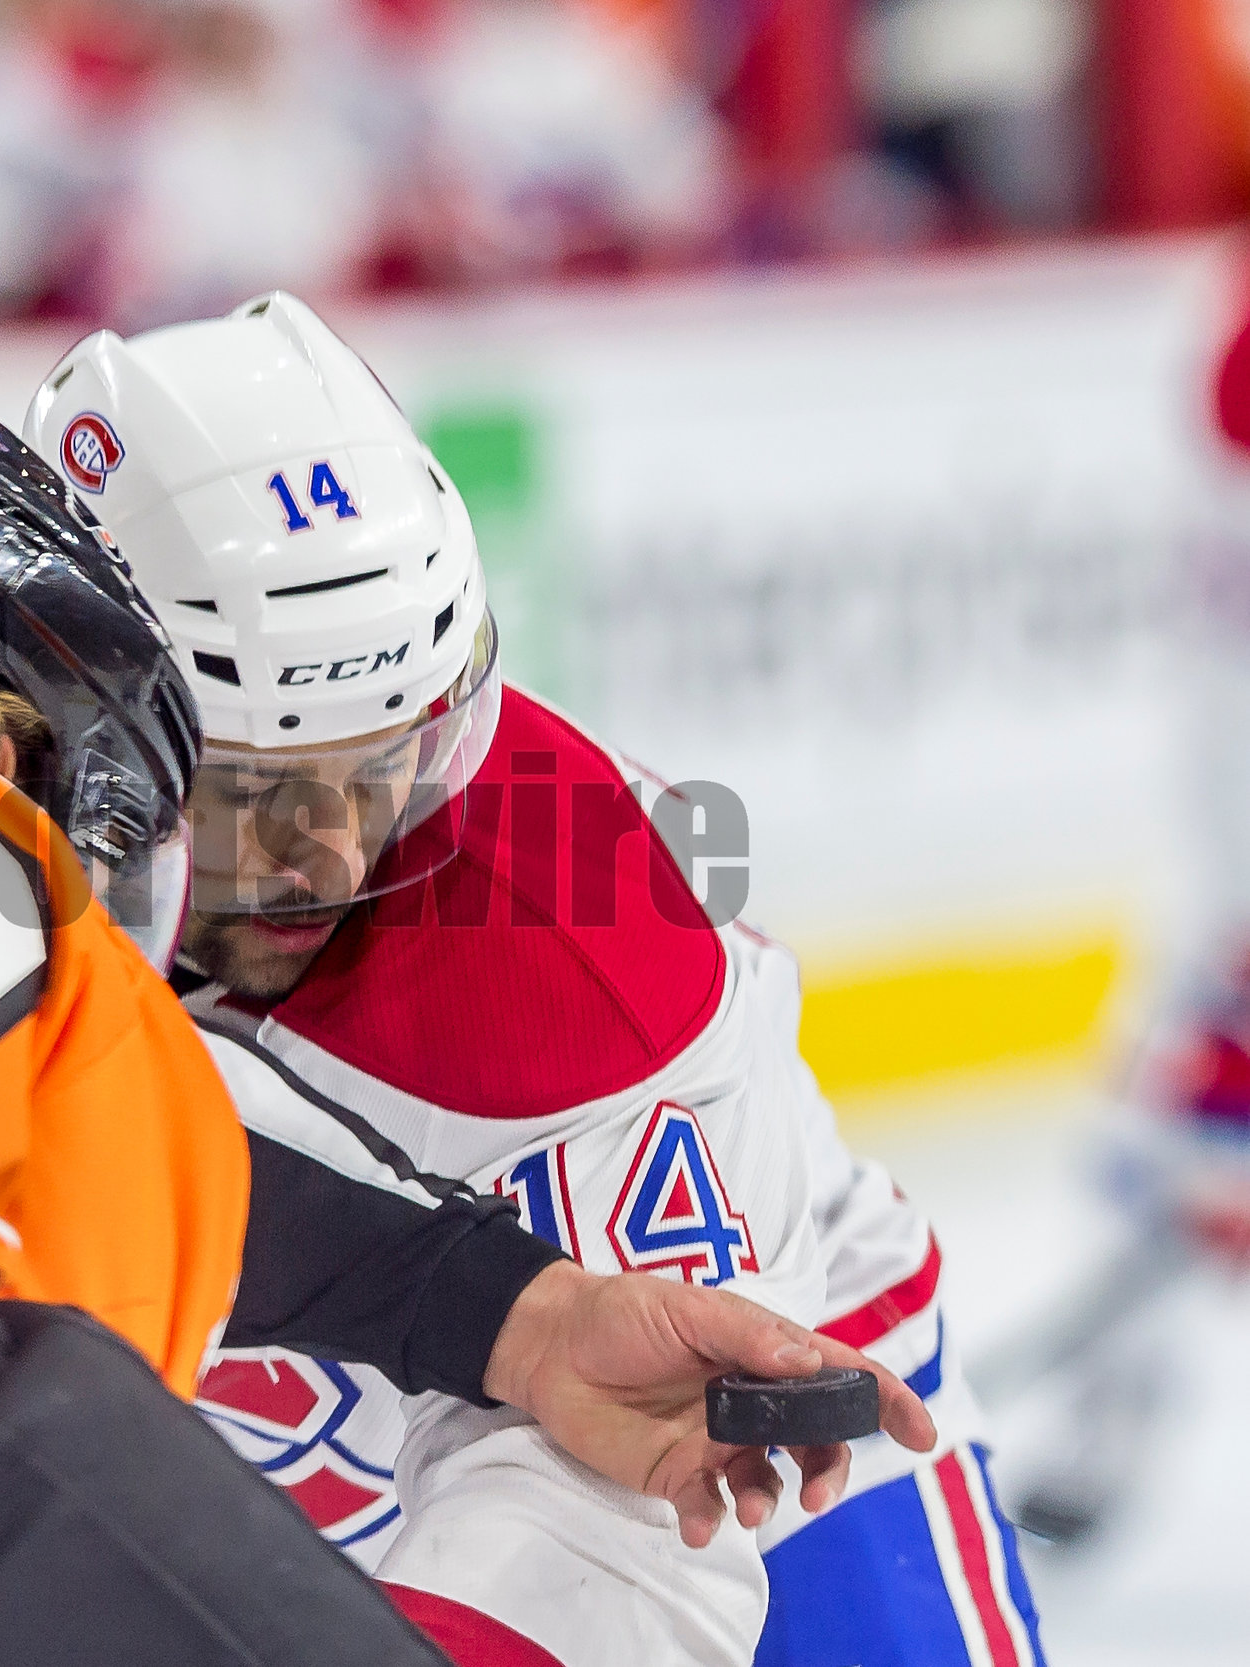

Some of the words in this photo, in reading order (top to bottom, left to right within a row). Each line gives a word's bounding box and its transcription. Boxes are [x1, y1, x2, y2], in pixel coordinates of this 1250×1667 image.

[266, 459, 362, 536] 14
[277, 641, 410, 686] CCM
[493, 1100, 760, 1288] 14
